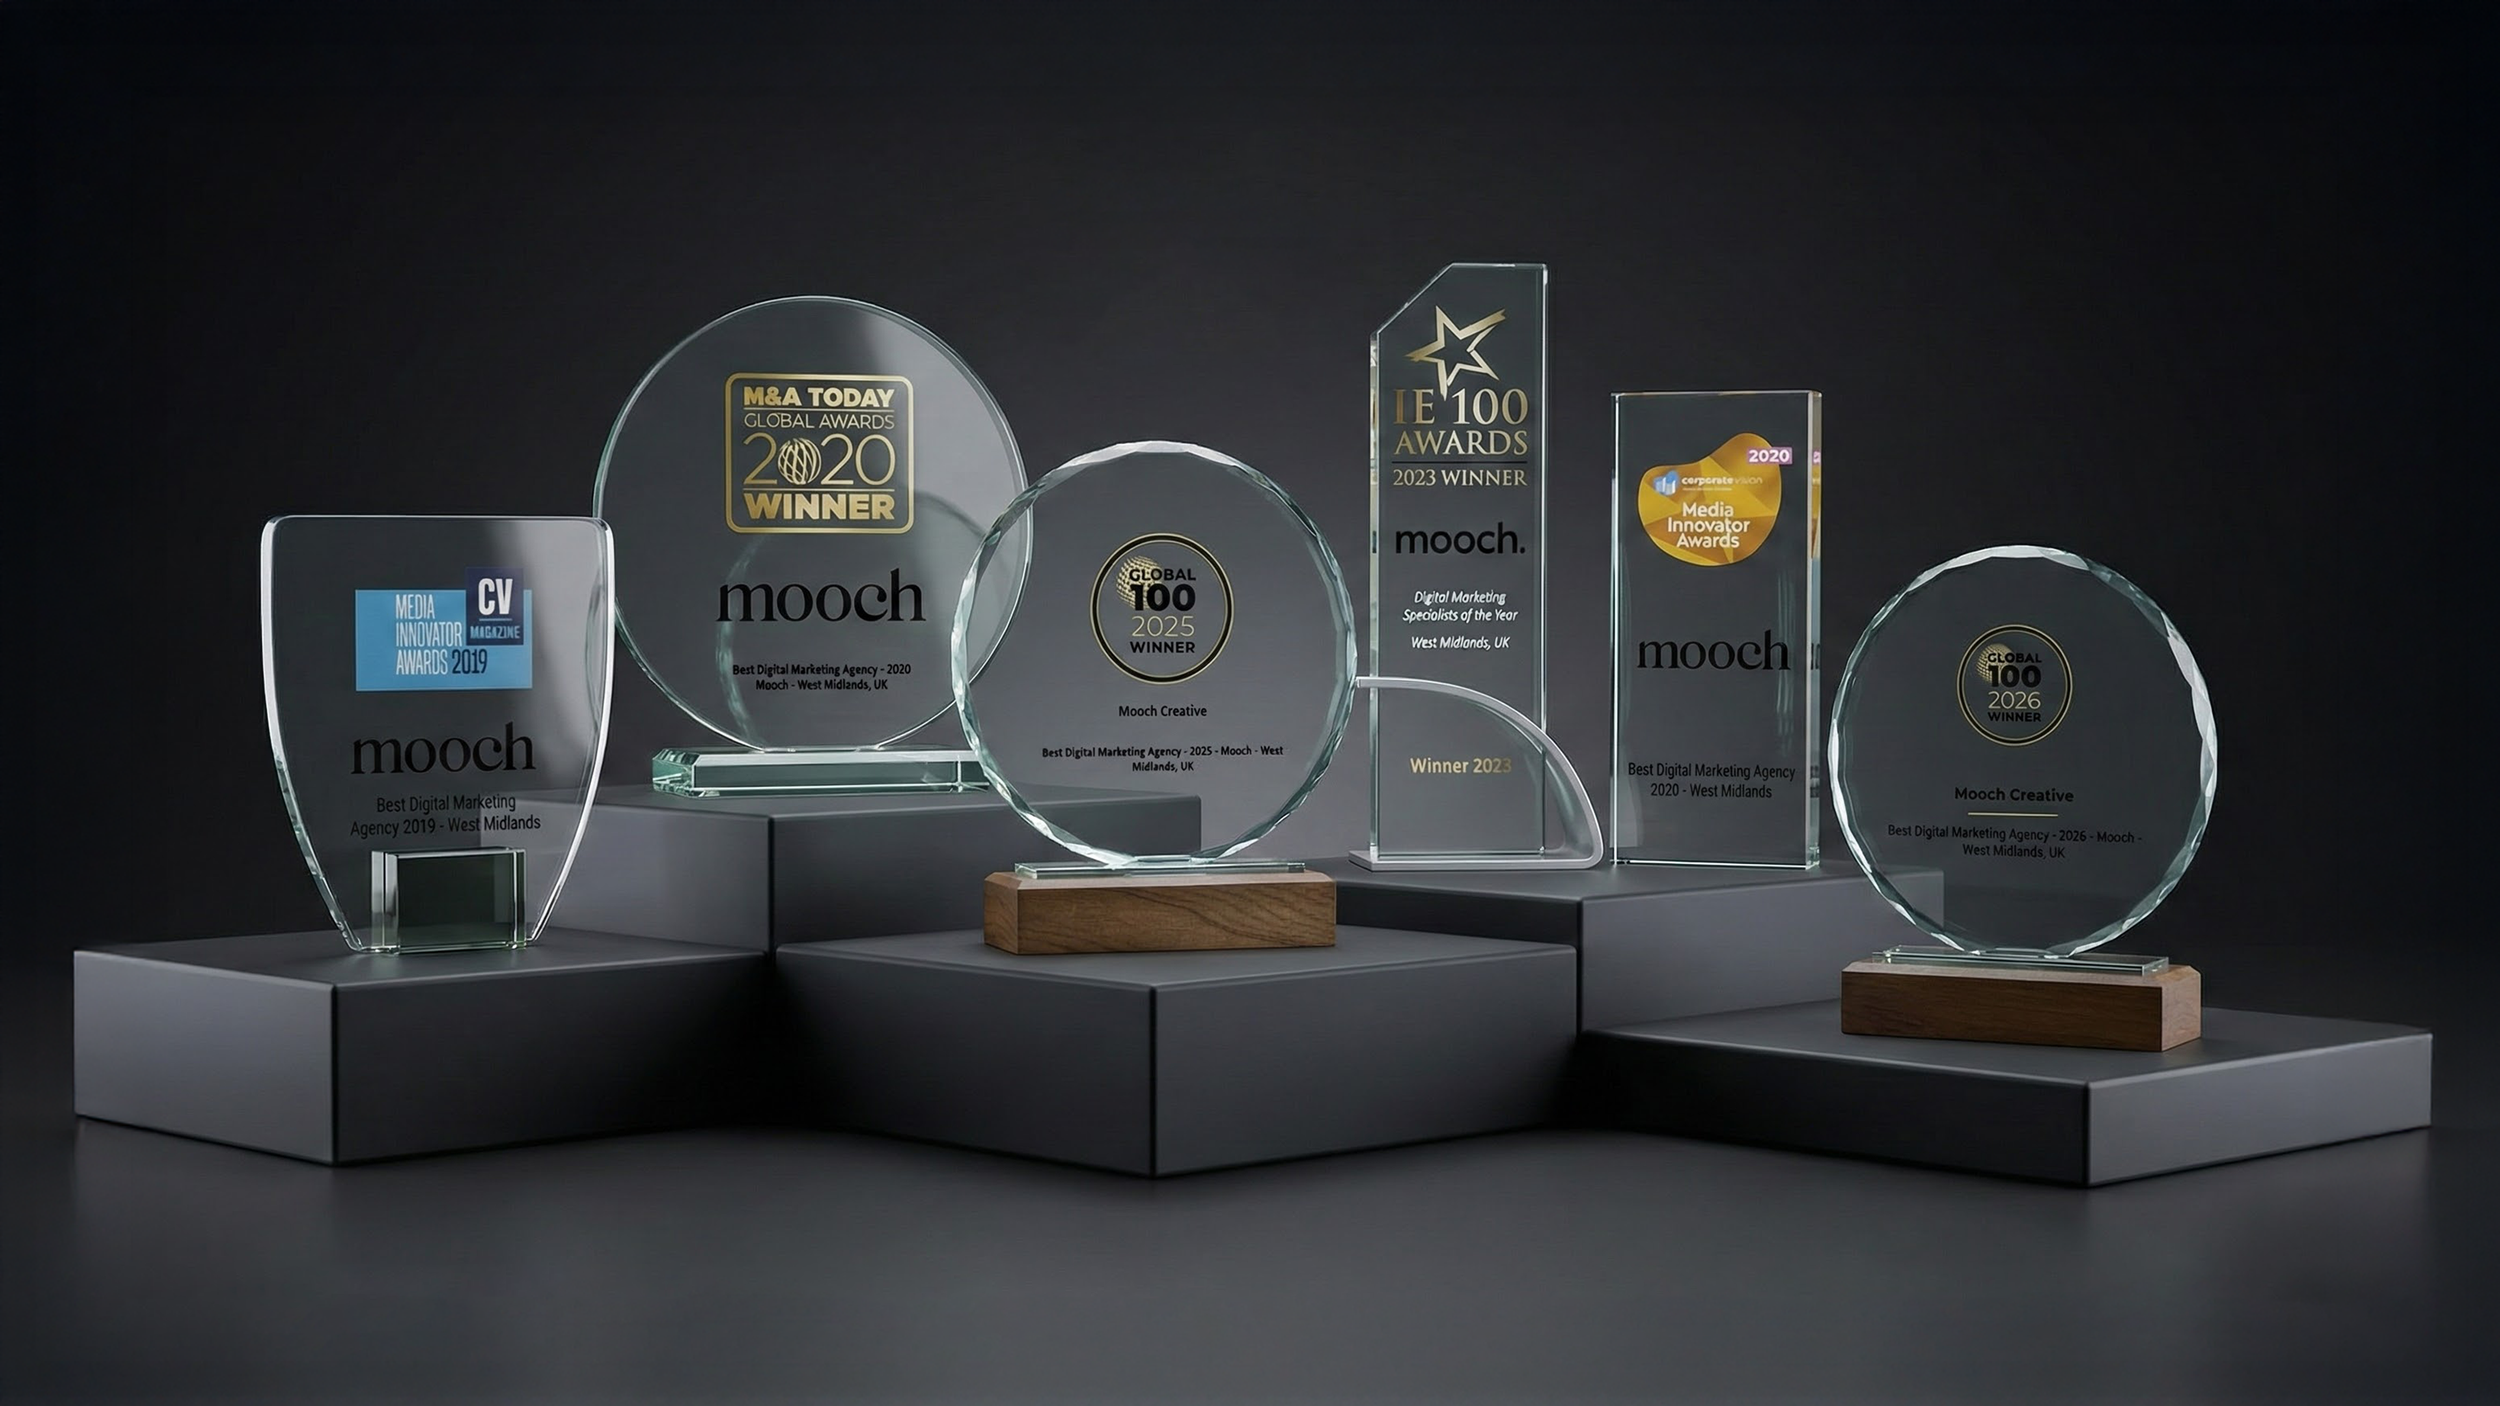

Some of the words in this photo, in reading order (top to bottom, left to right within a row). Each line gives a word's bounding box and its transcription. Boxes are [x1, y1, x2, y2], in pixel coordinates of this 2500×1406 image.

[743, 386, 802, 406] M&A
[807, 387, 895, 407] TODAY
[1393, 388, 1435, 424] IE
[1451, 388, 1528, 425] 100
[744, 413, 815, 428] GLOBAL
[819, 414, 895, 430] AWARDS
[1393, 430, 1528, 455] AWARDS
[743, 432, 896, 486] 2020
[1748, 449, 1790, 463] 2020
[1393, 469, 1436, 486] 2023
[1441, 469, 1527, 486] WINNER
[743, 493, 895, 520] WINNER
[1682, 501, 1734, 517] Media
[1667, 516, 1750, 533] Innovator
[1396, 521, 1526, 554] mooch.
[1676, 532, 1740, 548] Awards
[1129, 568, 1196, 581] GLOBAL
[478, 578, 513, 615] CV
[716, 568, 926, 622] mooch
[1130, 583, 1196, 611] 100
[1451, 590, 1506, 605] Marketing
[396, 594, 435, 619] MEDIA
[1460, 607, 1474, 623] of
[1475, 608, 1493, 621] the
[1495, 608, 1518, 621] Year
[396, 622, 462, 647] INNOVATOR
[470, 626, 520, 639] MAGAZINE
[1131, 616, 1195, 637] 2025
[1130, 641, 1195, 653] WINNER
[1411, 636, 1438, 648] West
[1494, 637, 1511, 648] UK
[1637, 629, 1791, 670] mooch
[396, 649, 448, 675] AWARDS
[452, 649, 488, 674] 2019
[1987, 653, 2041, 663] GLOBAL
[733, 664, 755, 675] Best
[757, 664, 789, 677] Digital
[791, 663, 840, 677] Marketing
[843, 666, 878, 678] Agency
[887, 664, 911, 674] 2020
[1988, 665, 2041, 688] 100
[756, 679, 789, 690] Mooch
[798, 680, 822, 690] West
[824, 679, 871, 691] Midlands,
[874, 680, 888, 690] UK
[1988, 691, 2041, 709] 2026
[1118, 705, 1157, 717] Mooch
[1161, 704, 1207, 717] Creative
[1987, 712, 2041, 722] WINNER
[351, 721, 536, 774] mooch
[1042, 747, 1063, 758] Best
[1065, 746, 1095, 759] Digital
[1098, 745, 1145, 758] Marketing
[1148, 747, 1182, 758] Agency
[1190, 746, 1212, 756] 2025
[1221, 744, 1252, 756] Mooch
[1260, 746, 1284, 755] West
[1132, 761, 1178, 772] Midlands,
[1180, 762, 1194, 771] UK
[1410, 757, 1469, 773] Winner
[1473, 758, 1512, 773] 2023
[1628, 762, 1653, 776] Best
[1656, 762, 1691, 780] Digital
[1695, 764, 1750, 780] Marketing
[1753, 765, 1796, 782] Agency
[1651, 783, 1679, 797] 2020
[1690, 784, 1718, 797] West
[1721, 784, 1772, 798] Midlands
[1955, 787, 2005, 801] Mooch
[2010, 788, 2074, 802] Creative
[377, 797, 406, 812] Best
[410, 796, 449, 815] Digital
[453, 793, 516, 811] Marketing
[350, 820, 400, 839] Agency
[403, 818, 436, 834] 2019
[449, 817, 481, 832] West
[484, 814, 541, 830] Midlands
[1888, 825, 1912, 836] Best
[1914, 826, 1949, 840] Digital
[1952, 826, 2006, 842] Marketing
[2009, 828, 2050, 843] Agency
[2059, 830, 2087, 841] 2026
[2097, 832, 2134, 843] Mooch
[1962, 844, 1990, 856] West
[1993, 845, 2046, 859] Midlands,
[2049, 847, 2066, 858] UK
